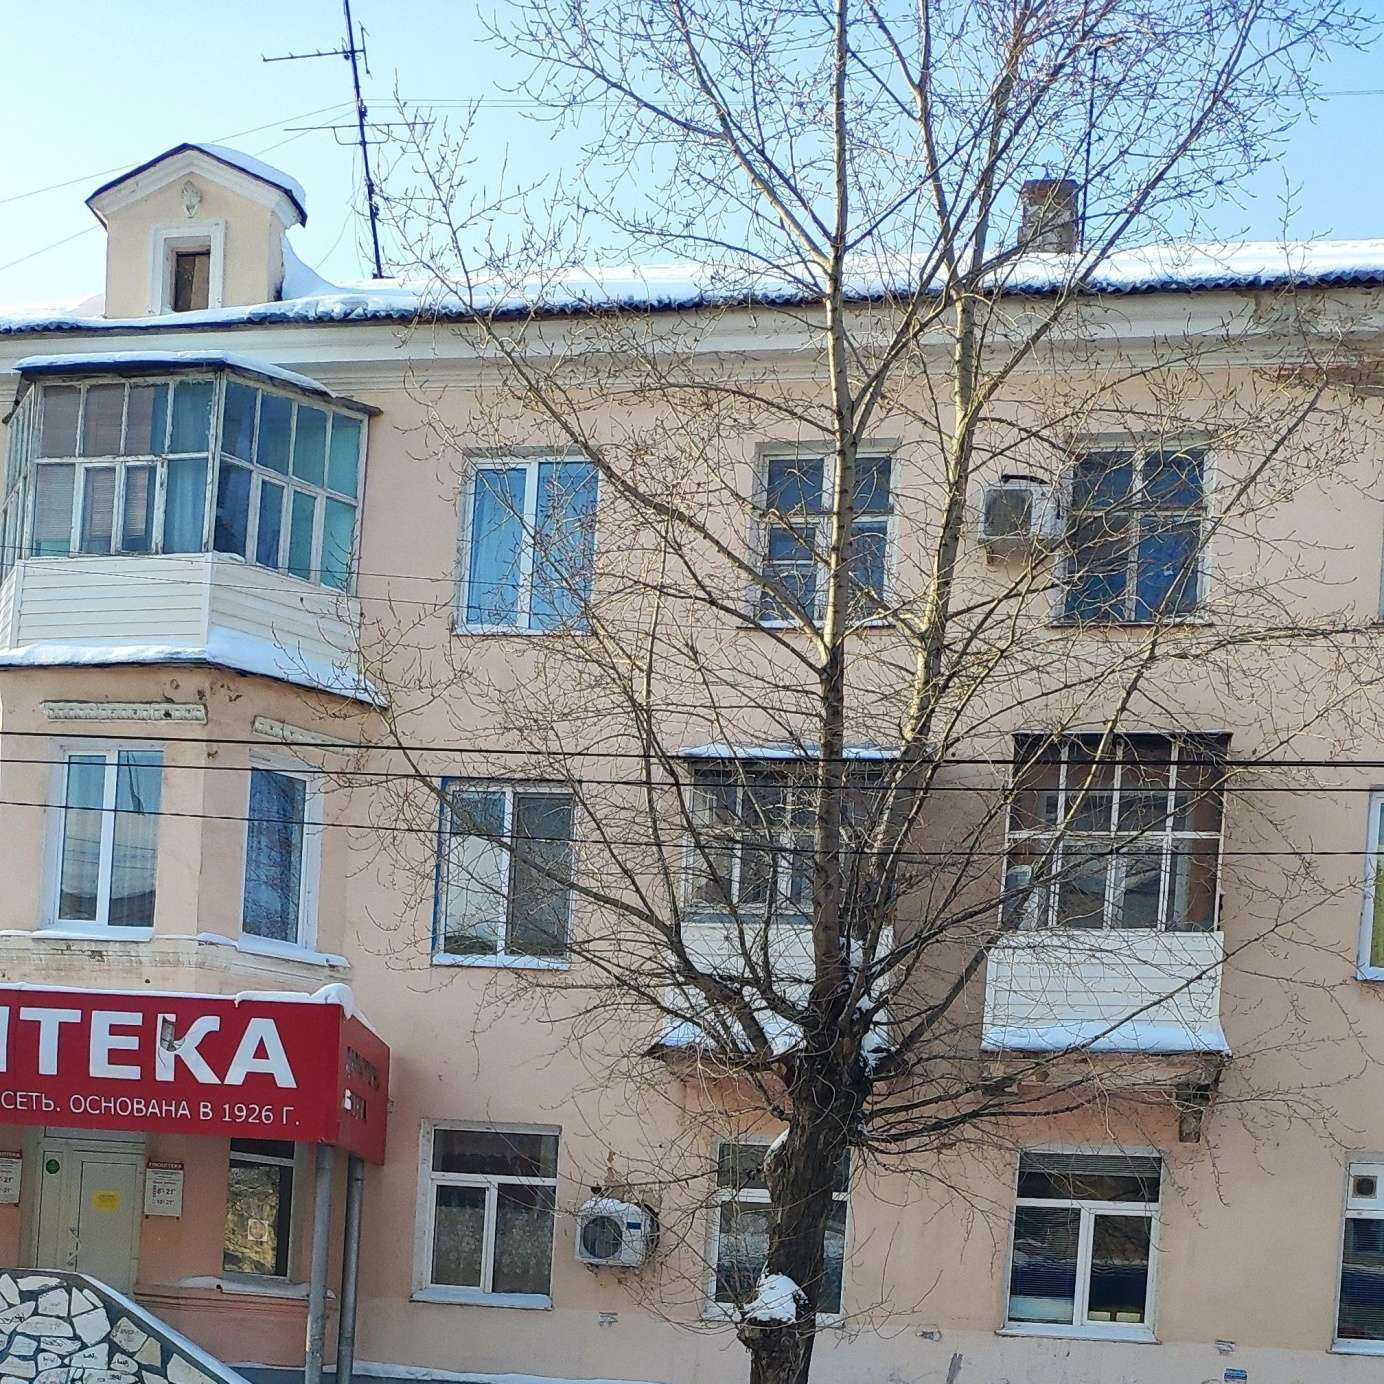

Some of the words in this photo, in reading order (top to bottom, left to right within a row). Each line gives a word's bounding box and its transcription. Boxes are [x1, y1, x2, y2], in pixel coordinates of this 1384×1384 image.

[0, 1006, 297, 1088] ТЕКА
[1, 1090, 61, 1112] СЕТЬ.
[69, 1094, 191, 1119] ОСНОВАНА
[199, 1101, 213, 1120] В
[222, 1103, 274, 1124] 1926
[281, 1106, 301, 1126] Г.
